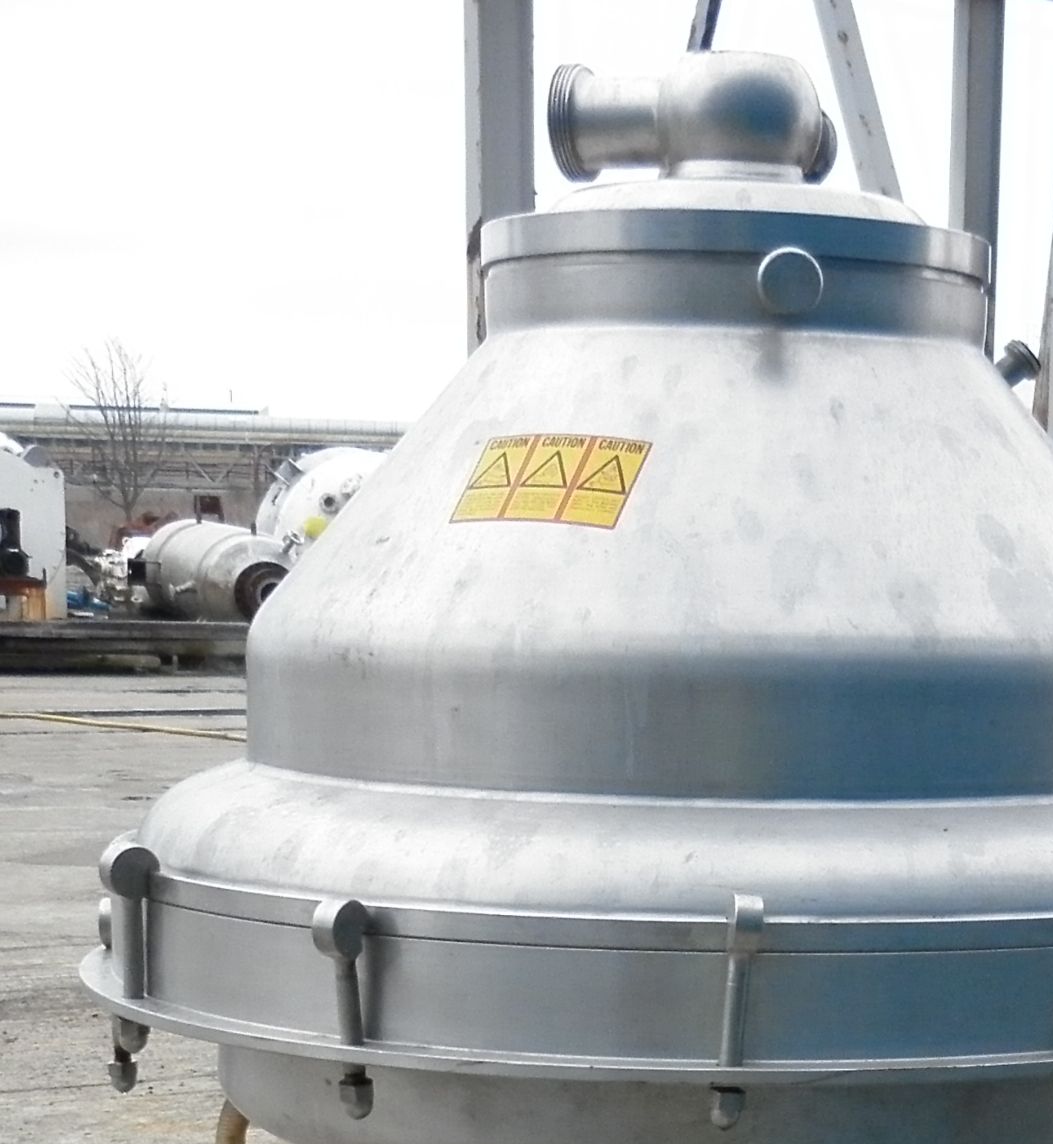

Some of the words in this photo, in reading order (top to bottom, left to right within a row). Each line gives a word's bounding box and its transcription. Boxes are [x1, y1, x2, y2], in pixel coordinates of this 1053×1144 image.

[489, 437, 530, 450] CAUTION
[541, 436, 587, 449] CAUTION
[598, 439, 646, 455] CAUTION
